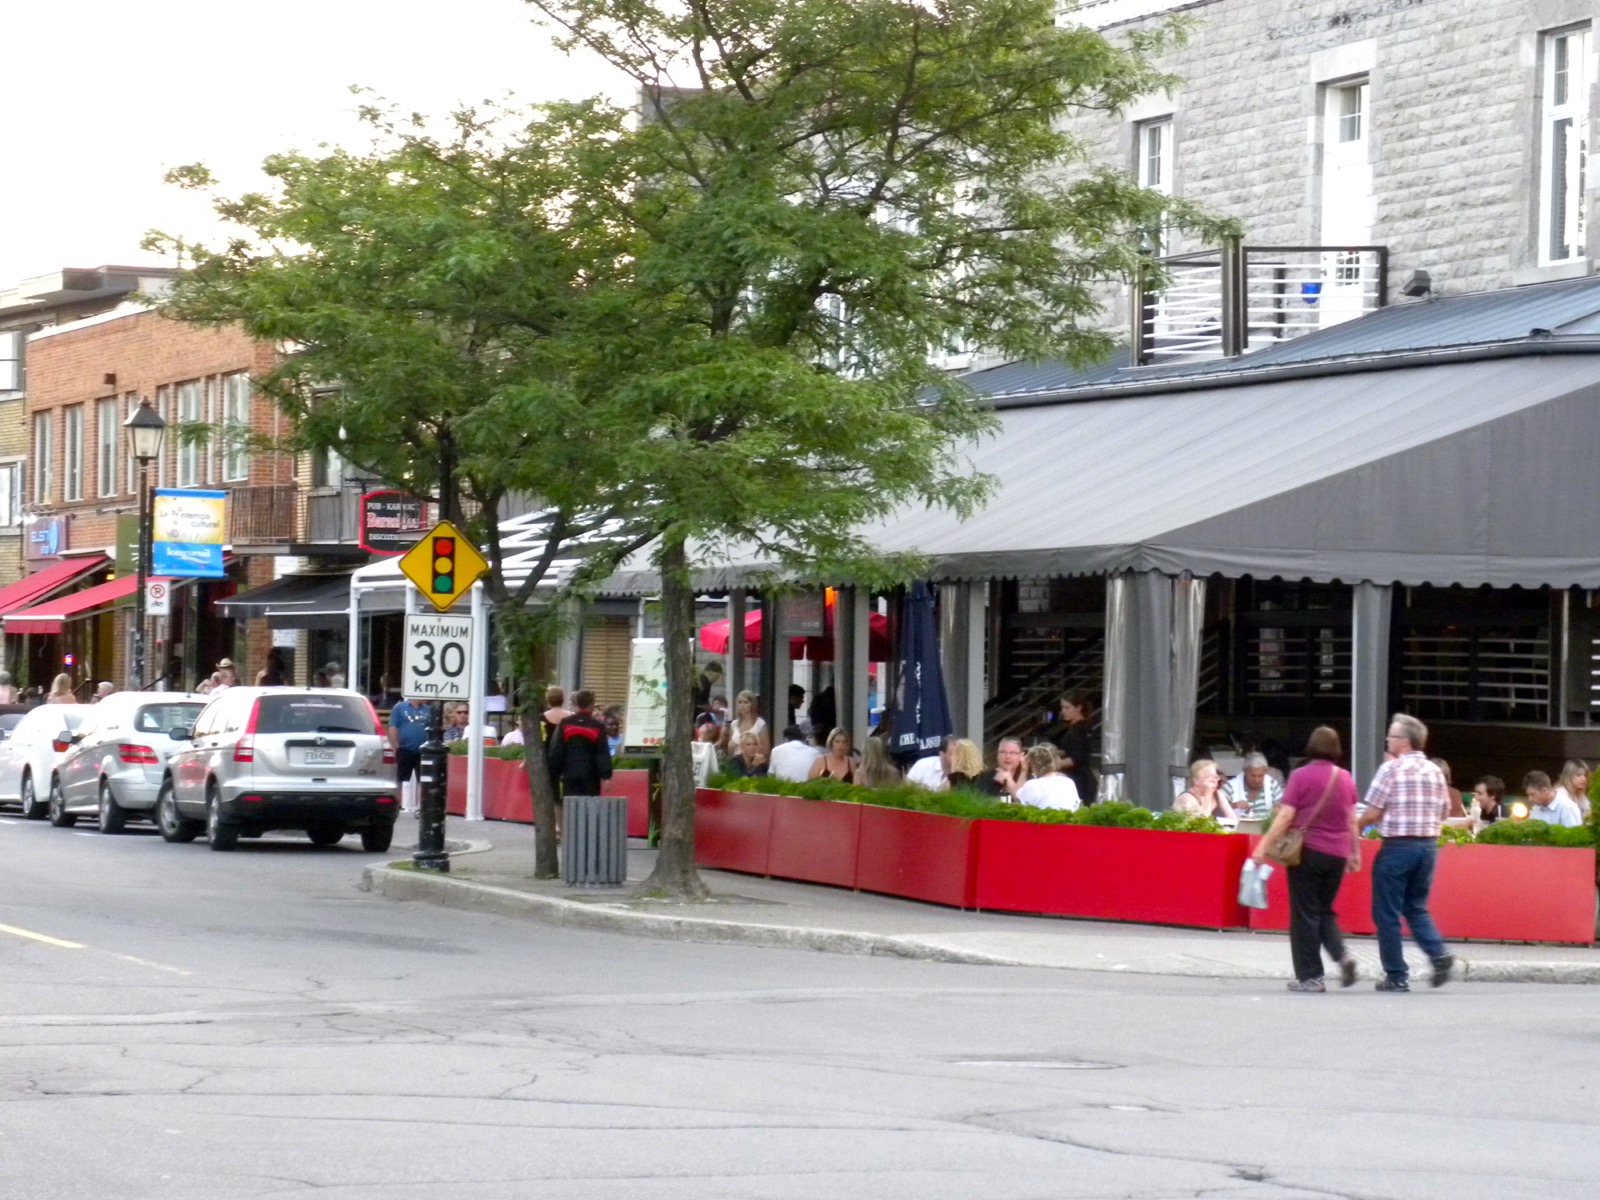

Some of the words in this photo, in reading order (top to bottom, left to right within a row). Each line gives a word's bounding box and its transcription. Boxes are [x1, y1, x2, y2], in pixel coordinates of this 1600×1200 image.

[367, 502, 381, 510] PUB
[191, 520, 220, 528] culturel
[410, 623, 469, 639] MAXIMUM
[411, 640, 465, 678] 30
[414, 680, 459, 694] km/h
